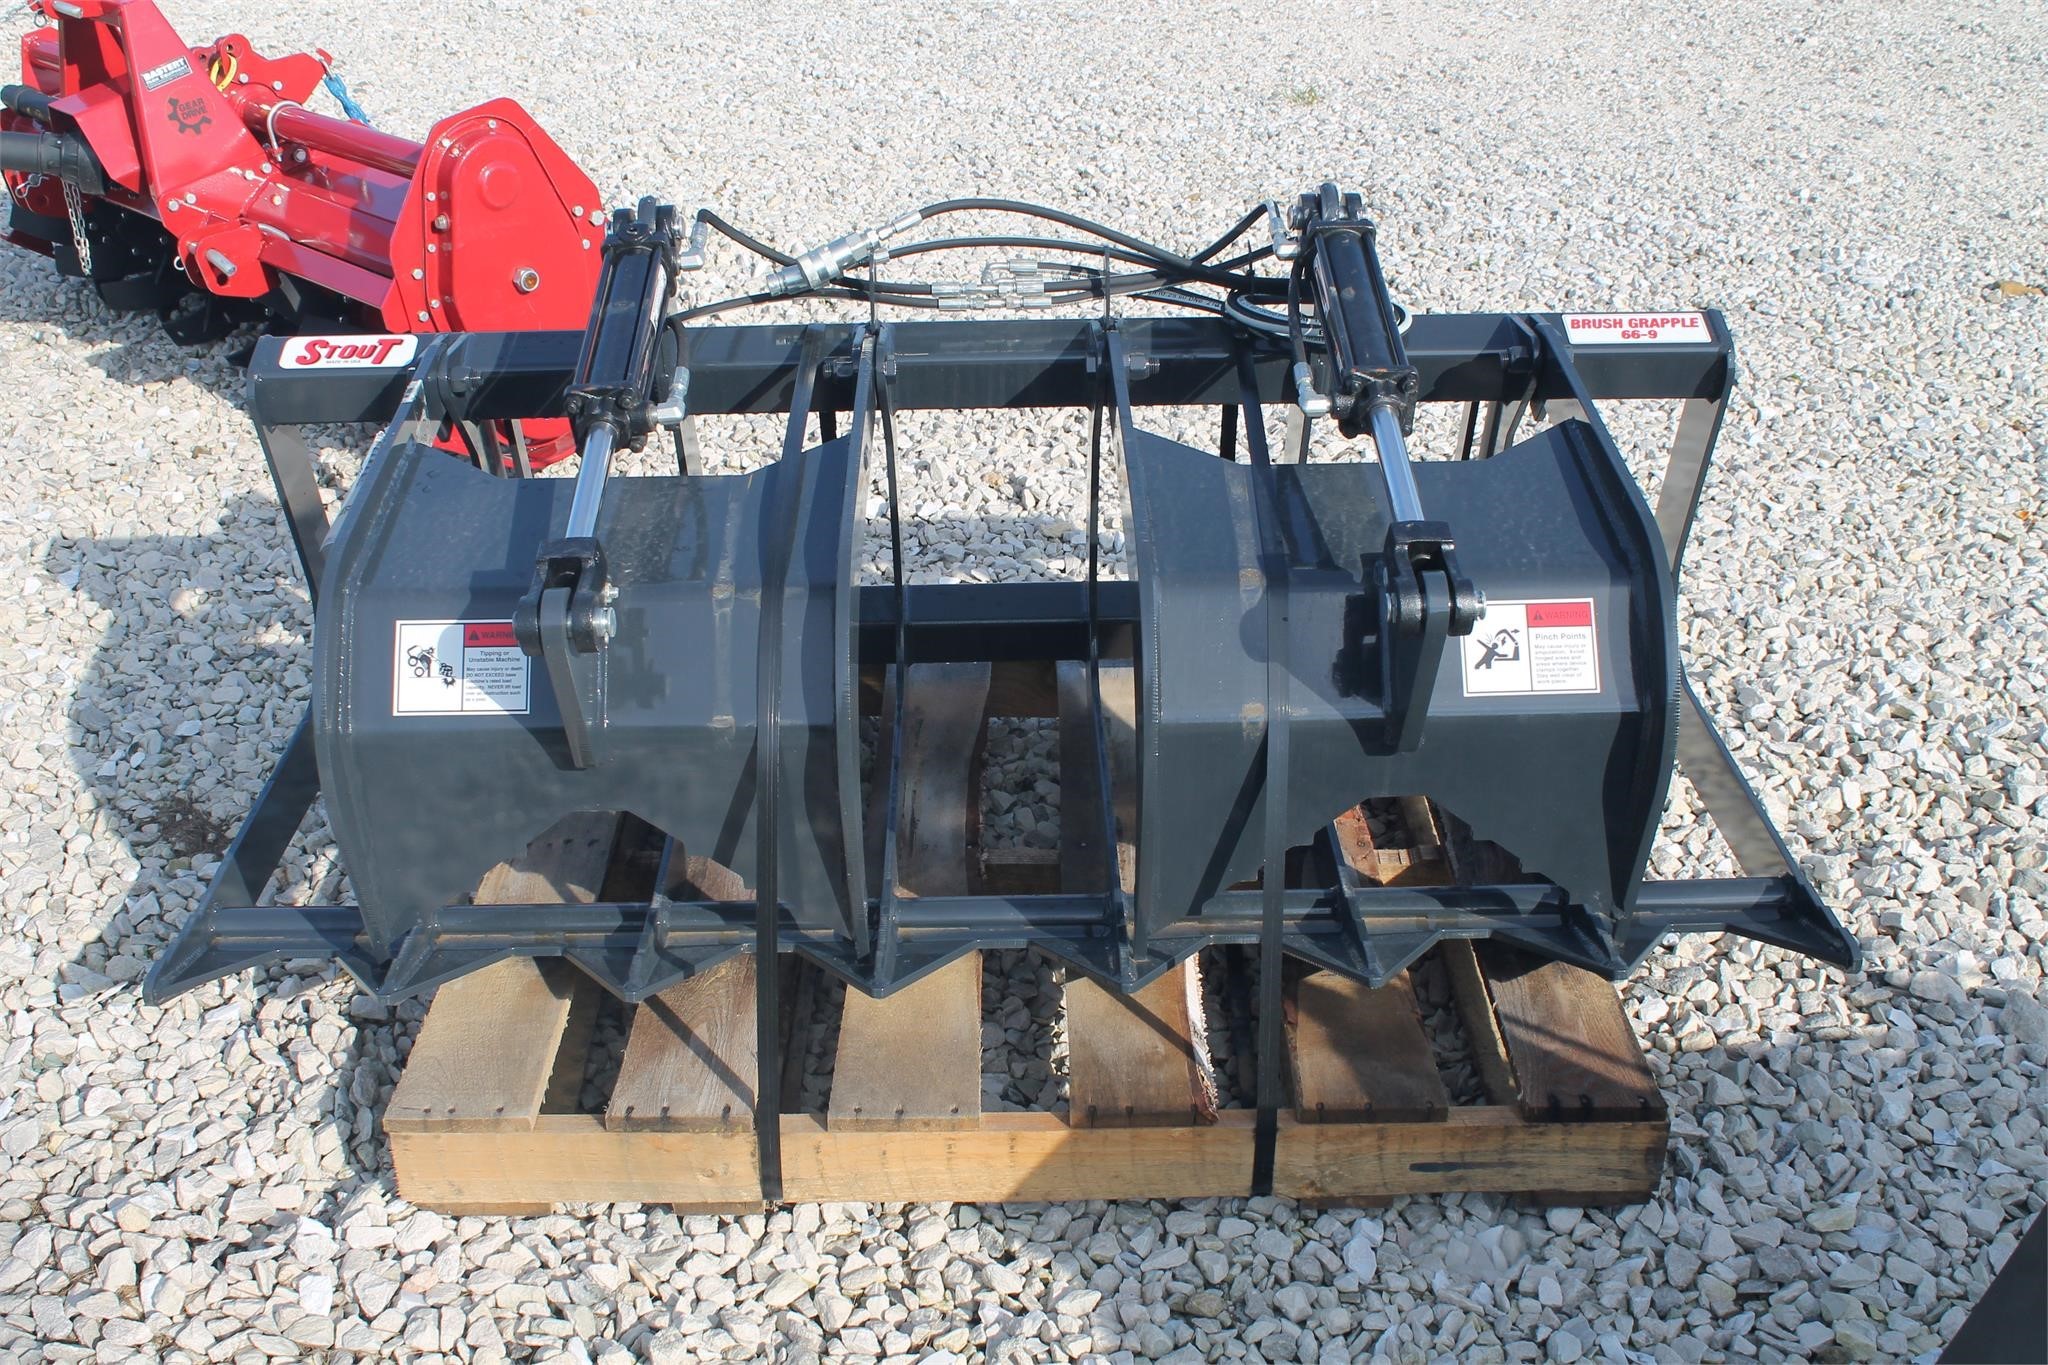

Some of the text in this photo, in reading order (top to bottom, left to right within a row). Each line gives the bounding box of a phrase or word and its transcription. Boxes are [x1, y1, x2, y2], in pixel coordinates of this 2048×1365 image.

[142, 58, 186, 81] BASTERT
[178, 98, 204, 111] GEAR
[182, 107, 207, 119] DRIVE
[1570, 317, 1699, 329] BRUSH GRAPPLE
[1621, 329, 1658, 339] 66-9
[1545, 610, 1589, 620] WARNING
[481, 631, 514, 639] WARNI
[1561, 632, 1587, 640] Points
